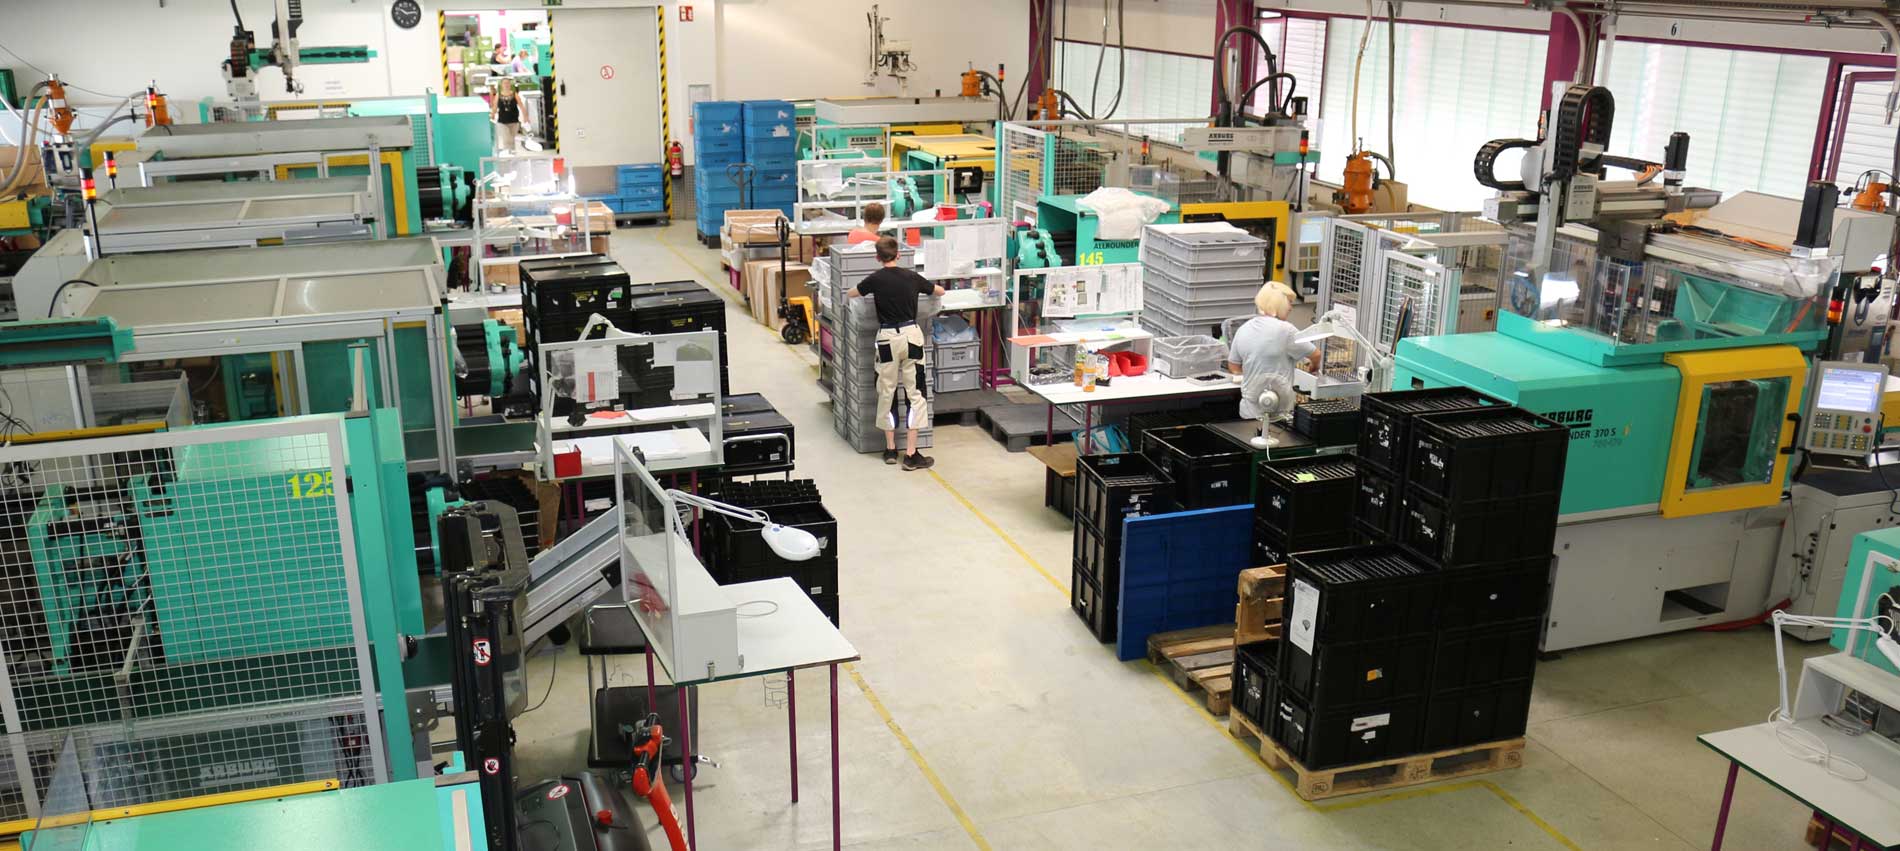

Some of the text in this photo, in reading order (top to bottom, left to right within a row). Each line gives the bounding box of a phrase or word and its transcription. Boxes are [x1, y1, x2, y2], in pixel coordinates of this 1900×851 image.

[1671, 22, 1678, 36] 6
[1094, 240, 1139, 250] ALLROUNDER
[1079, 251, 1104, 266] 145
[1542, 408, 1593, 424] RBURG
[1593, 427, 1610, 439] 370
[1610, 426, 1617, 437] S
[199, 759, 277, 780] ARBURG
